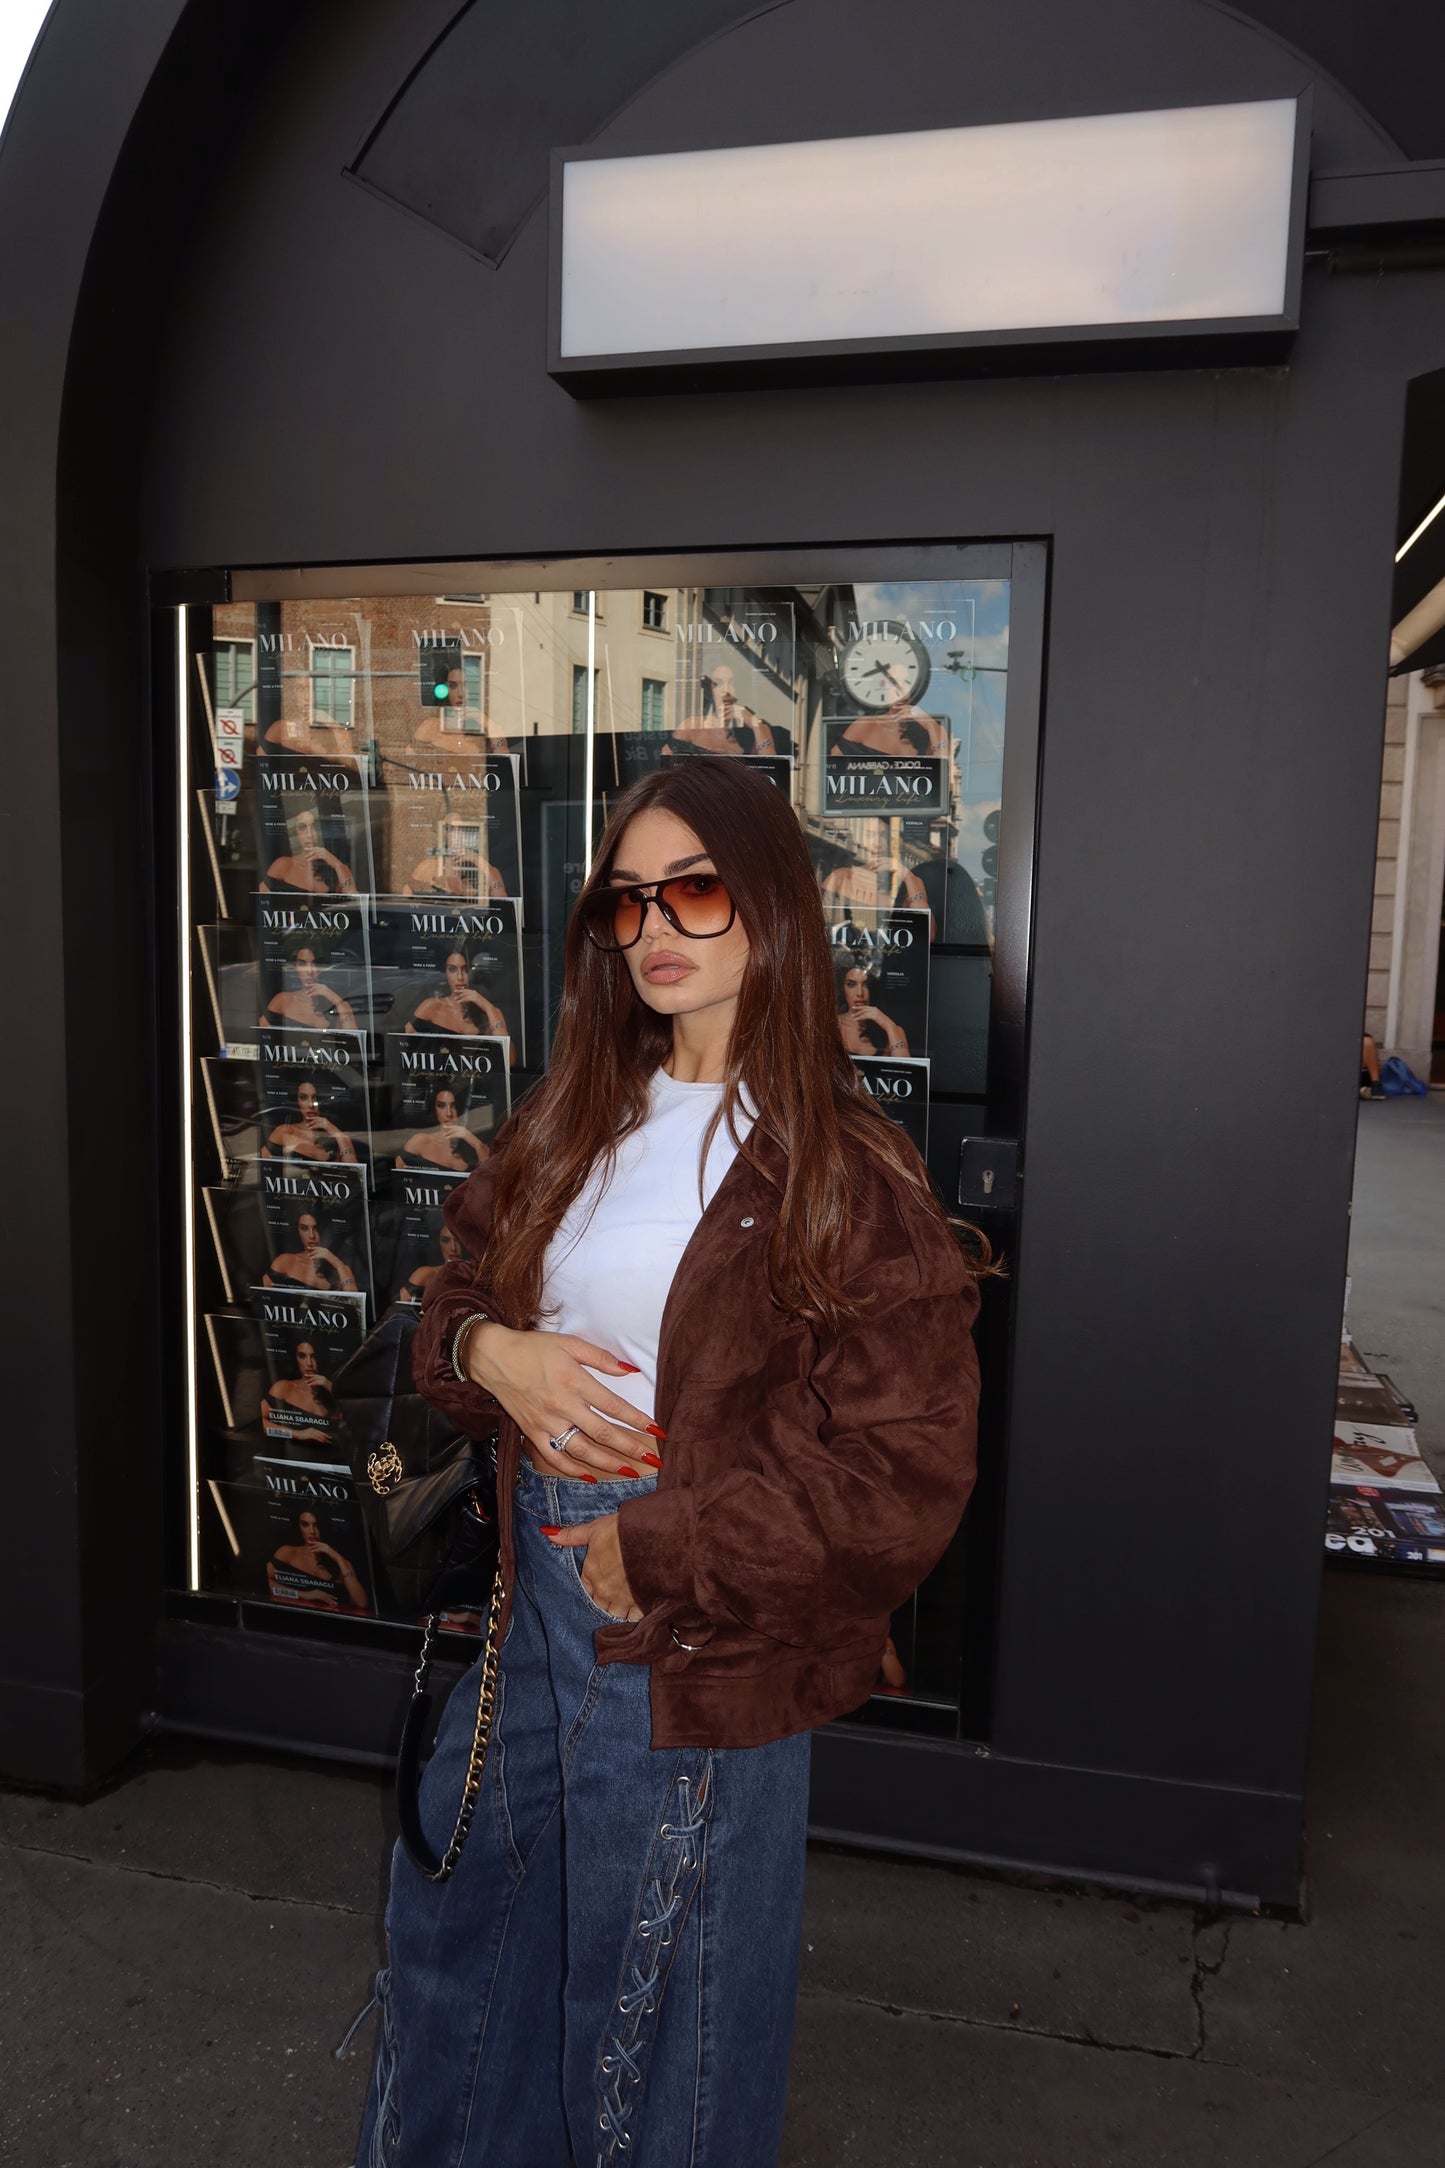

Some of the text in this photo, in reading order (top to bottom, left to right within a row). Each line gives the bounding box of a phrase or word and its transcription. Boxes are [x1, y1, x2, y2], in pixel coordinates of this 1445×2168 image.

[411, 626, 504, 648] MILANO
[676, 622, 777, 643] MILANO
[848, 620, 956, 641] MILANO
[259, 632, 348, 652] MILANO
[261, 773, 349, 791] MILANO
[408, 773, 500, 791] MILANO
[826, 775, 933, 795] MILANO
[262, 910, 350, 930] MILANO
[411, 914, 503, 934] MILANO
[831, 926, 913, 947] ILANO
[263, 1044, 350, 1065] MILANO
[400, 1052, 492, 1073] MILANO
[863, 1076, 913, 1097] ANO
[265, 1175, 350, 1198] MILANO
[405, 1187, 443, 1206] MIL
[264, 1305, 348, 1328] MILANO
[269, 1412, 294, 1421] ELIANA
[266, 1475, 348, 1500] MILANO
[275, 1573, 299, 1583] ELIANA
